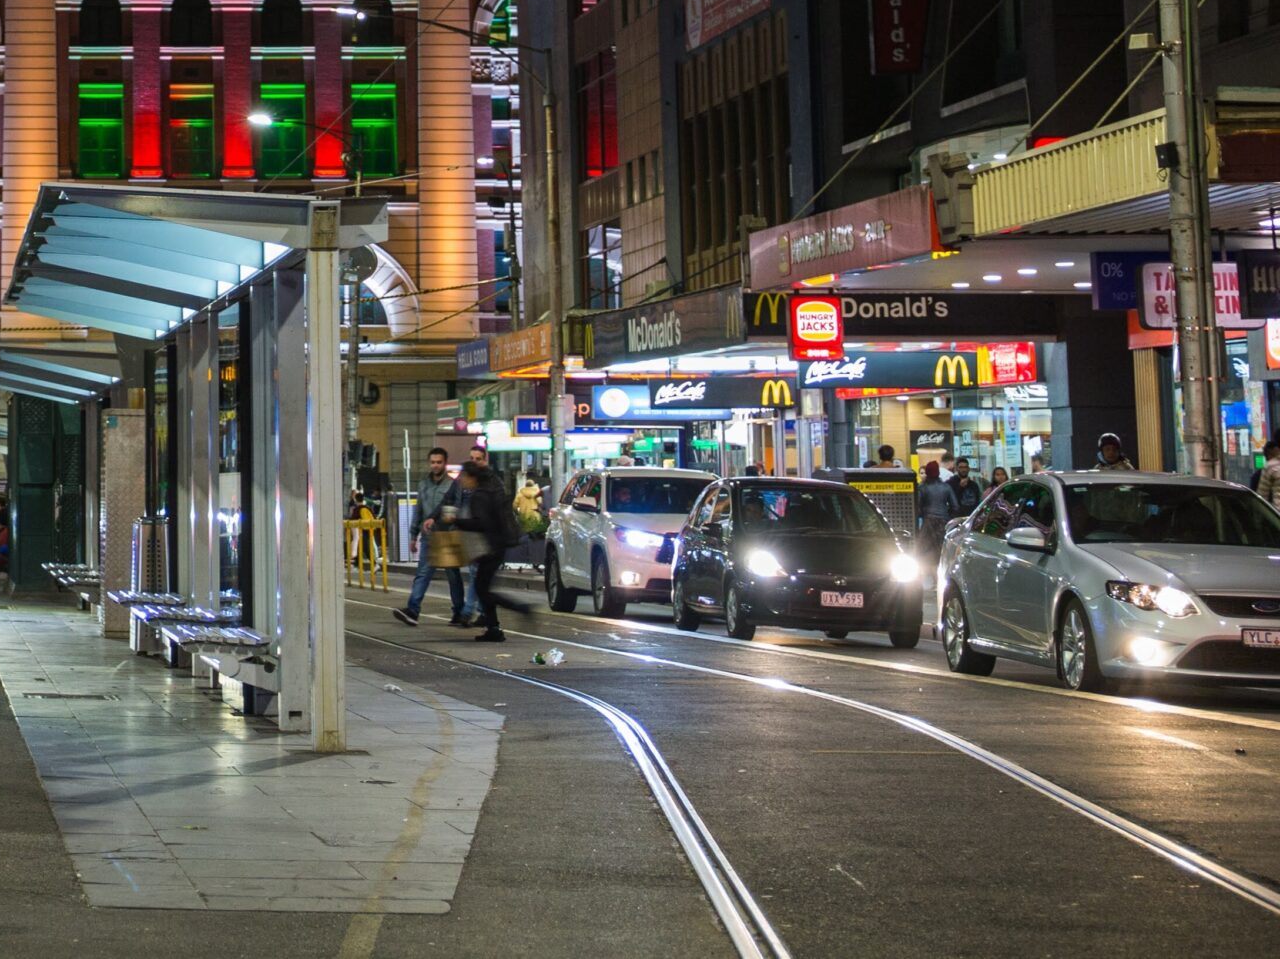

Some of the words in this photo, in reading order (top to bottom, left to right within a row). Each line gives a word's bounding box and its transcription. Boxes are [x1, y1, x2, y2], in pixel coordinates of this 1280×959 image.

[1100, 262, 1124, 278] 0%
[841, 296, 950, 319] Donald's
[1154, 295, 1170, 315] &
[799, 313, 834, 321] HUNGRY
[627, 310, 682, 353] McDonald's
